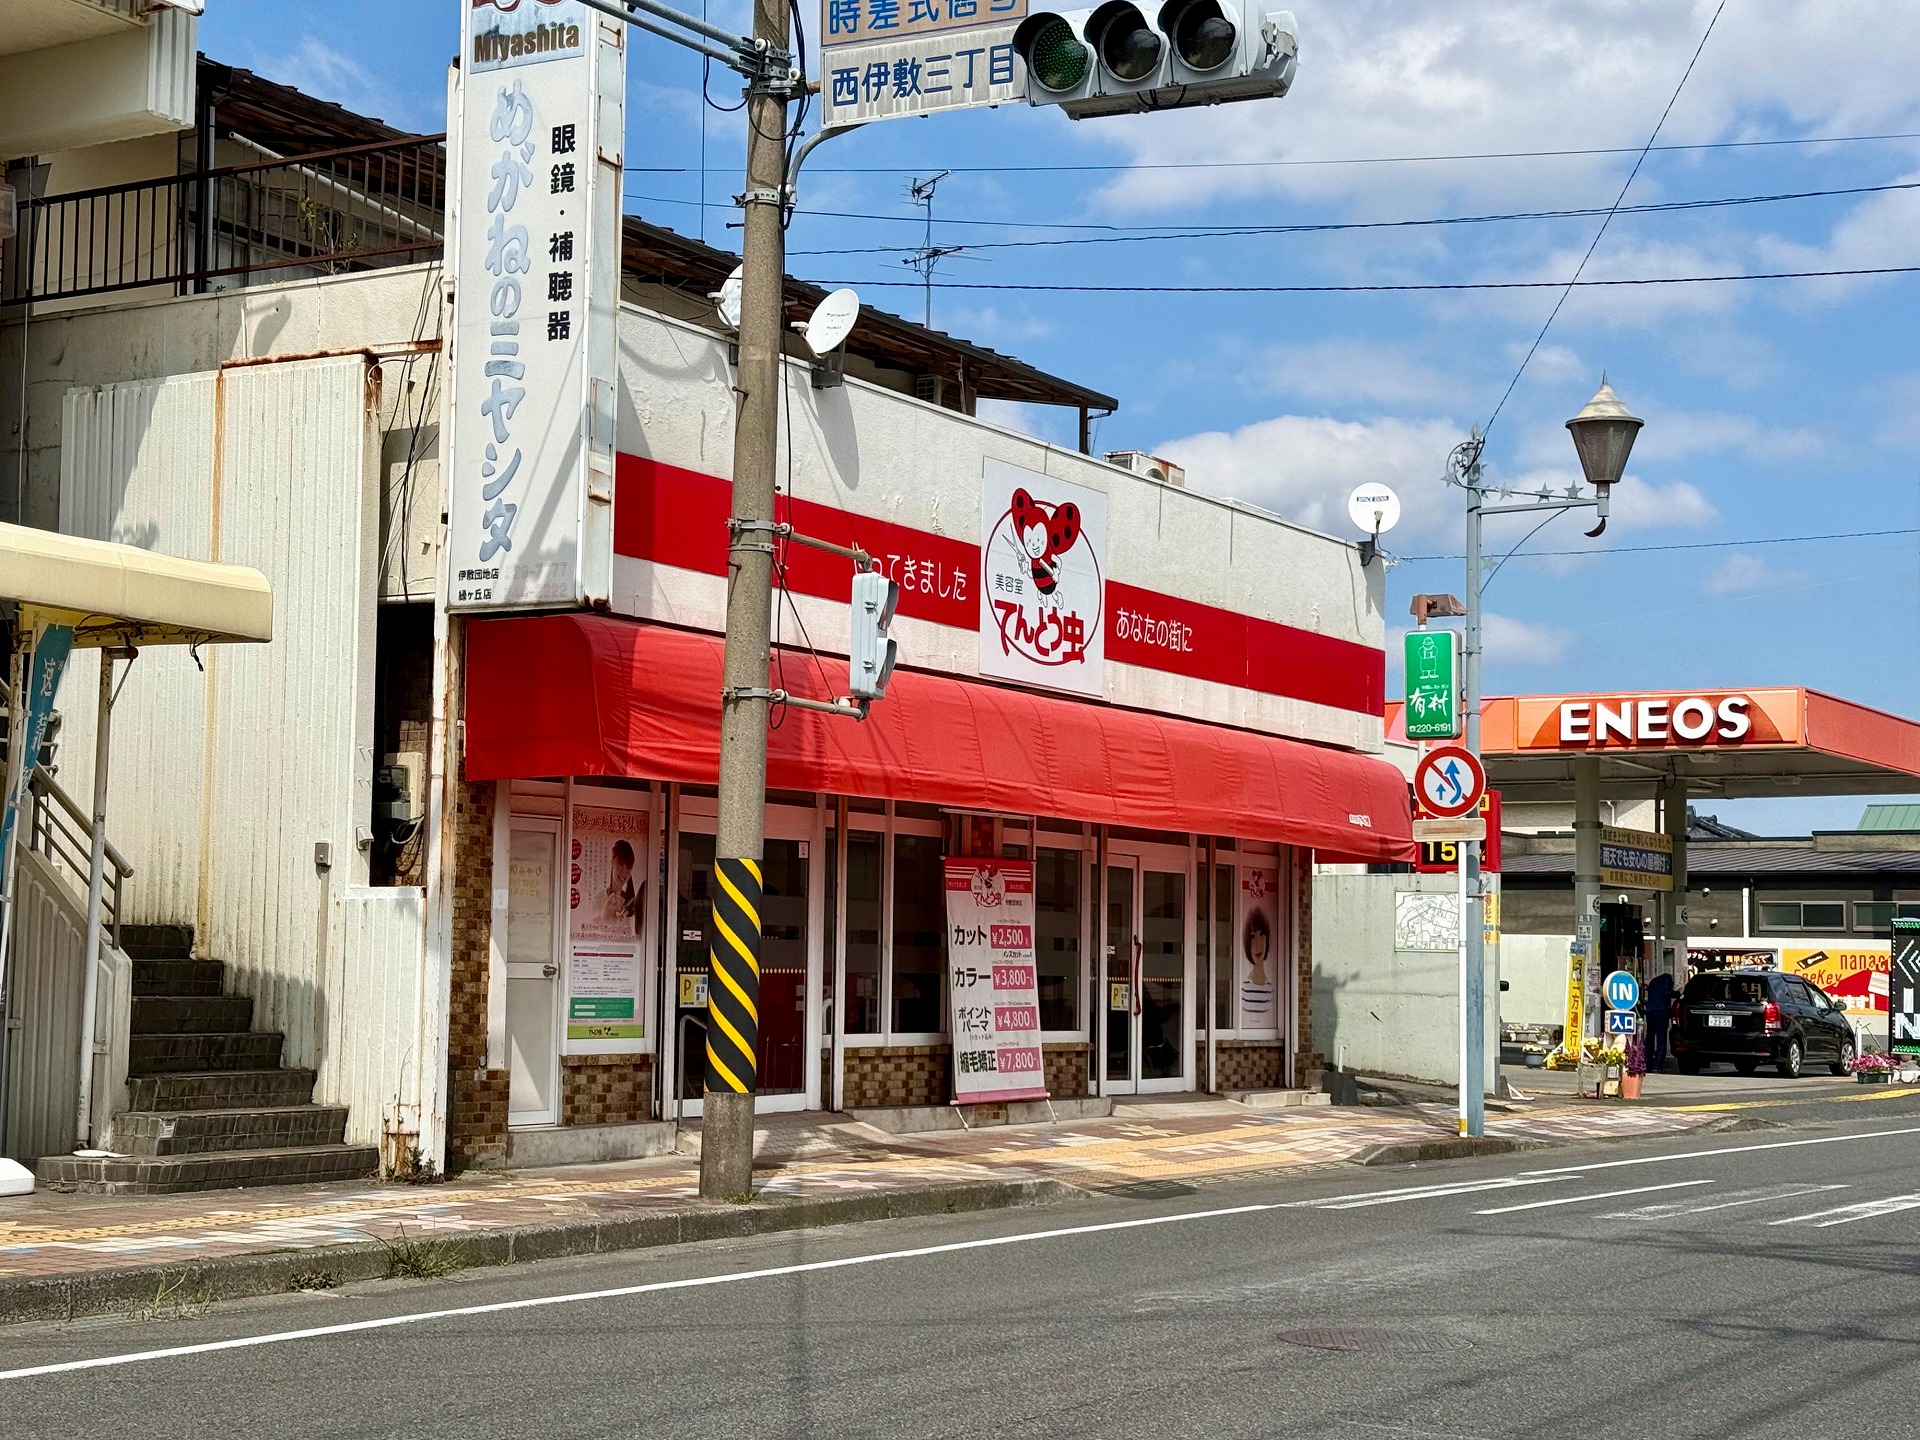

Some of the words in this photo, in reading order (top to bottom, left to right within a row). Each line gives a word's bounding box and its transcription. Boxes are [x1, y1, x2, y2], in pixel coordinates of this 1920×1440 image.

[474, 23, 579, 63] Miyashita
[831, 44, 1014, 107] 西伊敷三丁目
[547, 124, 576, 341] 眼鏡・補聴器
[479, 79, 535, 562] めがねのミヤシタ
[458, 568, 500, 581] 伊敷団地店
[995, 573, 1024, 596] 美容室
[994, 599, 1086, 664] てんとう虫
[1116, 606, 1194, 653] あなたの街に
[1408, 687, 1449, 718] 有村
[1416, 723, 1452, 735] 220-6191
[1559, 697, 1751, 743] ENEOS
[954, 924, 988, 949] カット
[992, 928, 1024, 949] ¥2,500
[954, 967, 991, 988] カラー
[1612, 982, 1633, 1002] IN
[958, 1006, 992, 1021] ポイント
[1612, 1015, 1634, 1031] 入口
[962, 1020, 990, 1033] パーマ
[959, 1050, 997, 1073] 縮毛矯正
